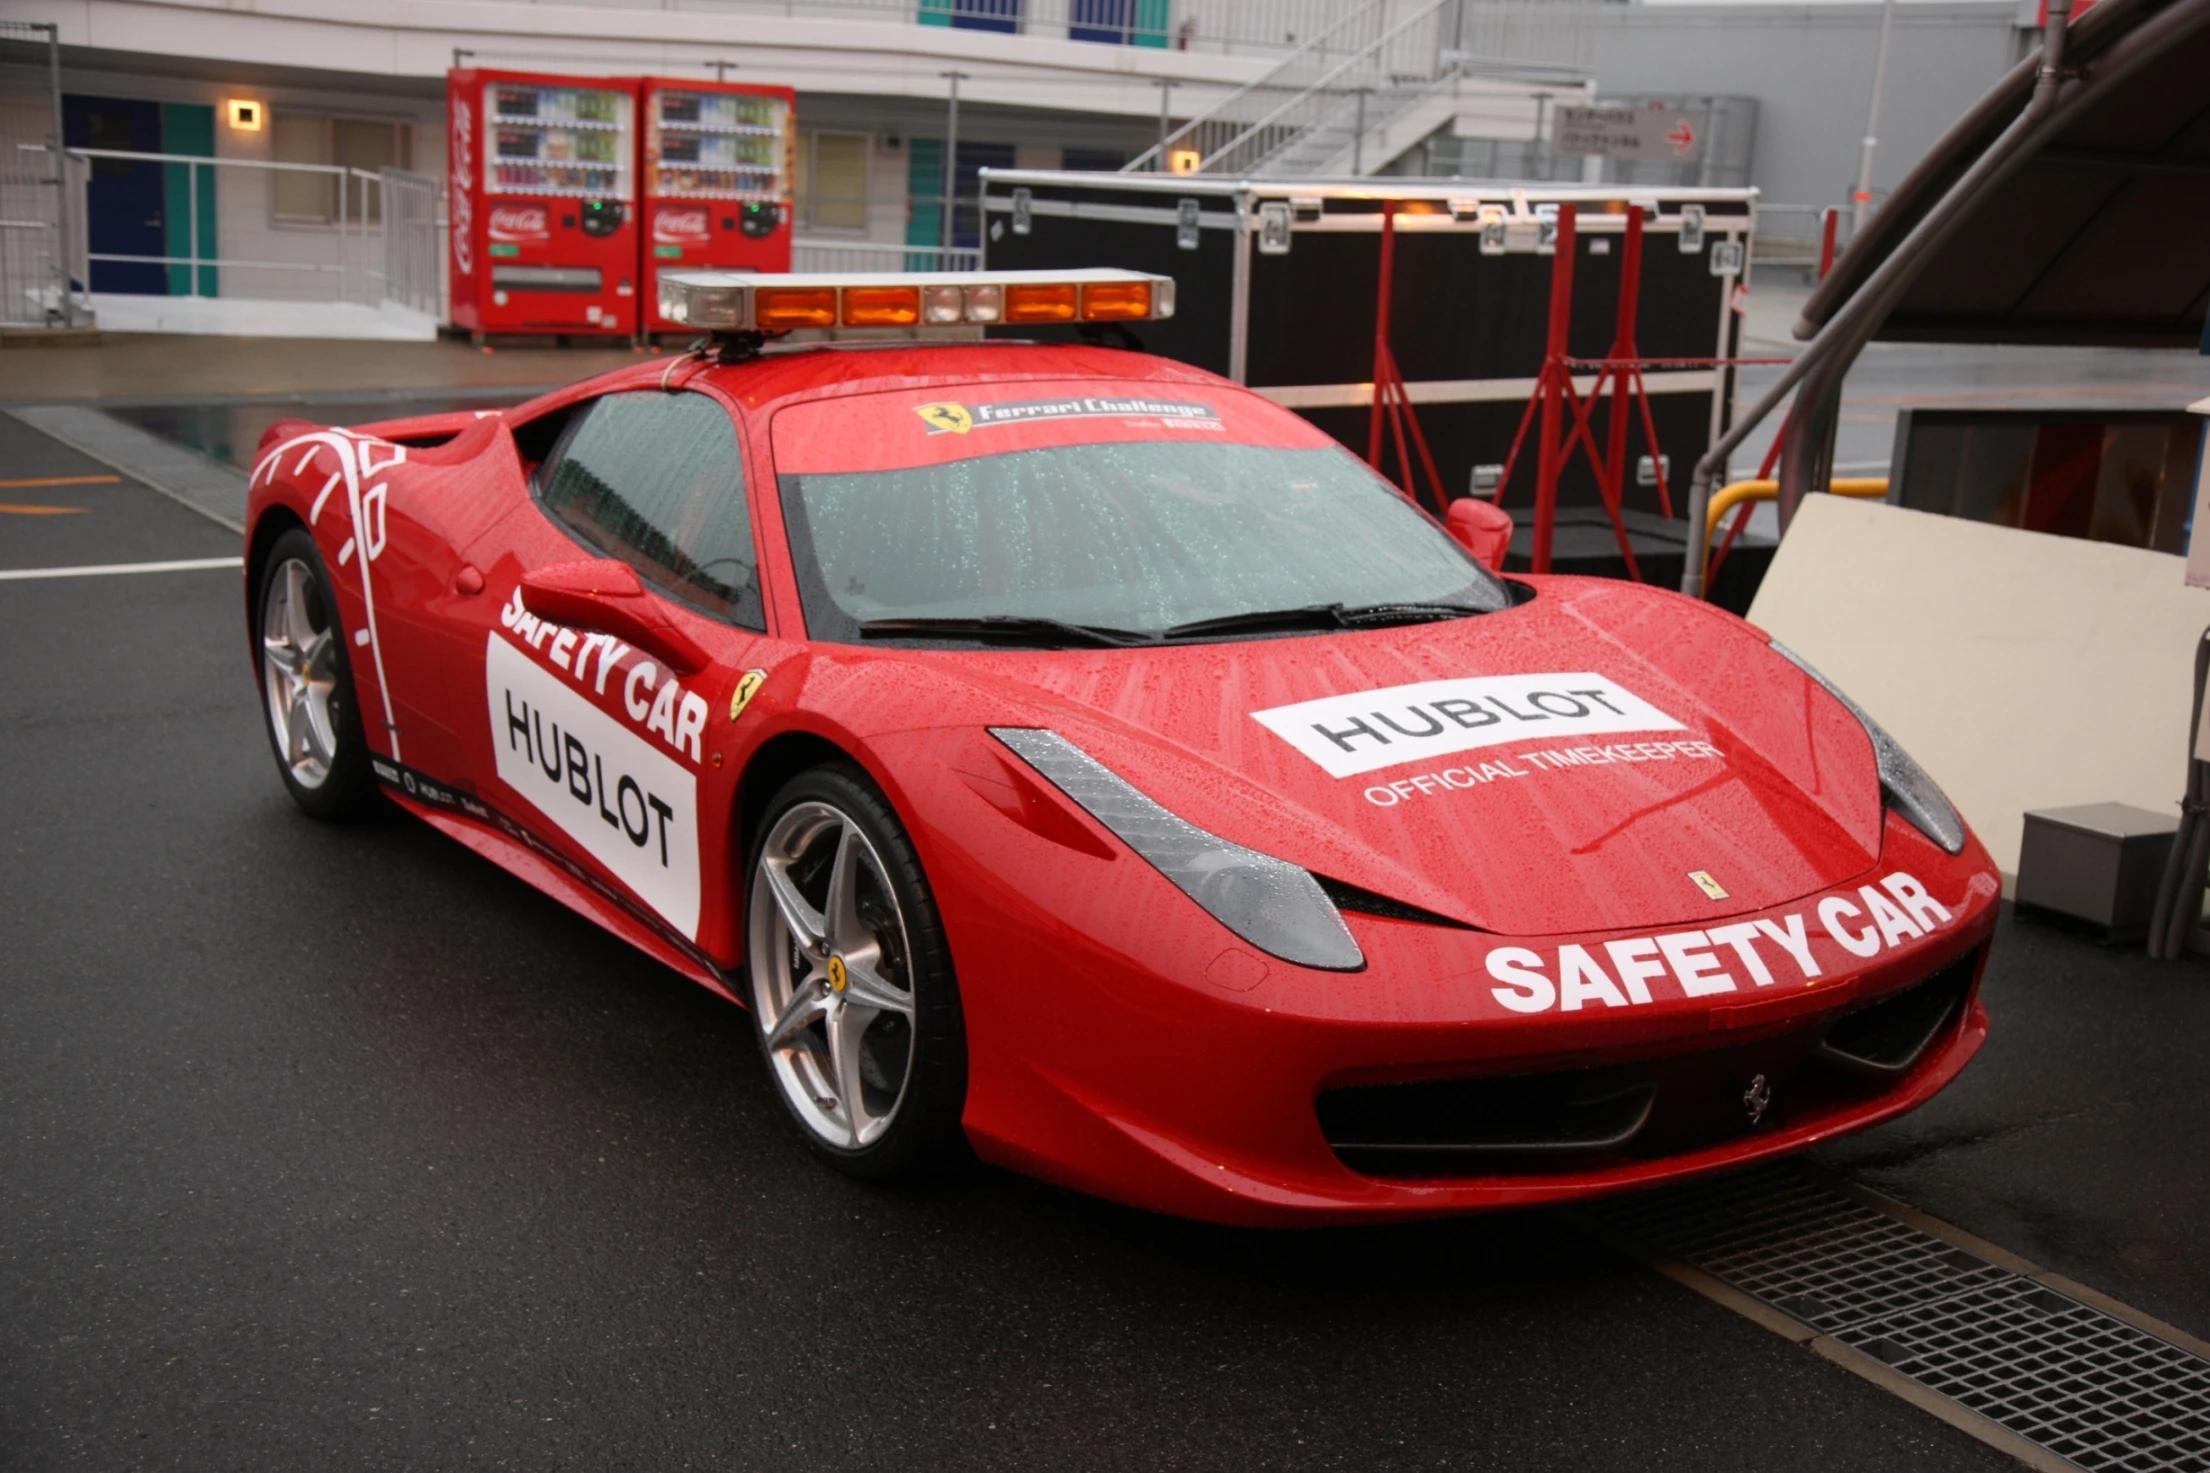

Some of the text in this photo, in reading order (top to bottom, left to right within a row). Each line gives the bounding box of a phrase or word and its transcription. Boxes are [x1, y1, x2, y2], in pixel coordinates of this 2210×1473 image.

[978, 398, 1207, 421] Ferrari Challenge
[624, 661, 708, 765] CAR
[1311, 689, 1627, 753] HUBLOT
[505, 688, 674, 868] HUBLOT
[1363, 740, 1726, 808] OFFICIAL TIMEKEEPER
[1484, 871, 1953, 1014] SAFETY CAR
